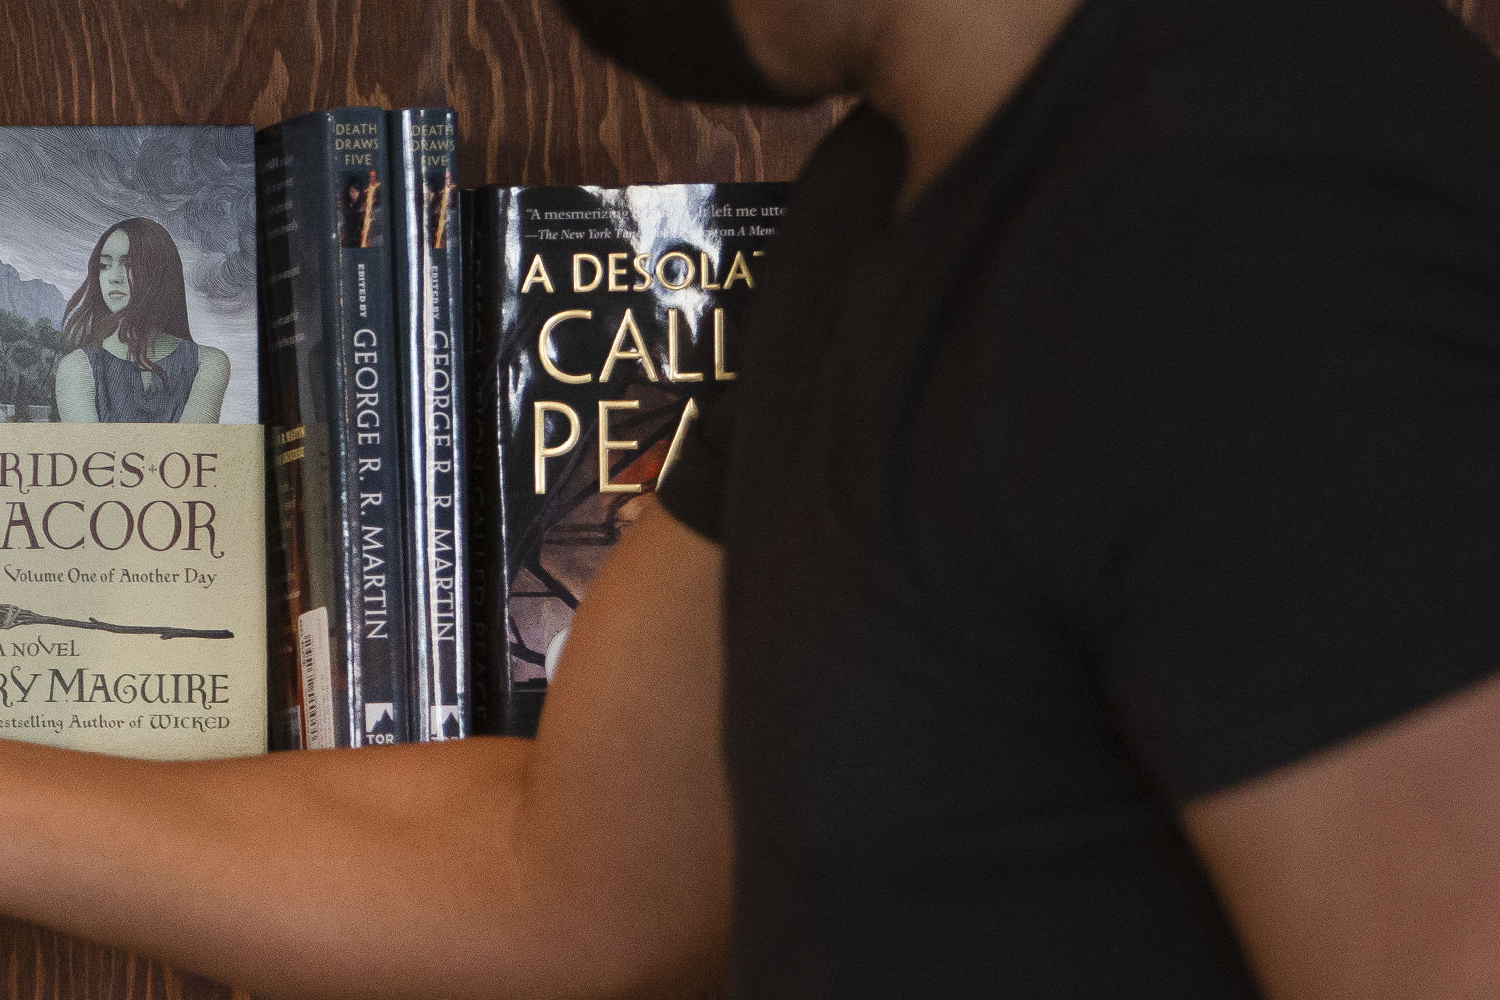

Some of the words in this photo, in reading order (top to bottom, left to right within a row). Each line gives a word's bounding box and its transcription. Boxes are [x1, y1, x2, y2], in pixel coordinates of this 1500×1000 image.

[335, 123, 378, 135] DEATH
[412, 124, 454, 136] DEATH
[334, 138, 380, 151] DRAWS
[411, 139, 456, 151] DRAWS
[344, 154, 372, 166] FIVE
[420, 155, 447, 166] FIVE
[544, 208, 629, 222] mesmerizing
[711, 204, 732, 217] left
[735, 207, 757, 217] me
[560, 229, 585, 240] New
[588, 228, 611, 239] York
[719, 229, 735, 237] on
[737, 226, 746, 236] A
[521, 253, 555, 294] A
[572, 250, 765, 293] DESOLA
[353, 328, 381, 445] GEORGE
[427, 331, 451, 447] GEORGE
[158, 451, 218, 489] OF
[358, 457, 381, 481] R.
[360, 491, 382, 516] R.
[3, 563, 65, 585] Volume
[67, 568, 97, 584] One
[100, 567, 115, 584] of
[118, 567, 181, 584] Another
[184, 567, 217, 588] Day
[361, 525, 388, 639] MARTIN
[432, 528, 455, 642] MARTIN
[11, 635, 80, 658] NOVEL
[47, 667, 230, 710] MAGUIRE
[69, 714, 125, 729] Author
[129, 714, 144, 729] of
[149, 713, 230, 732] WICKED
[366, 733, 395, 745] TOR
